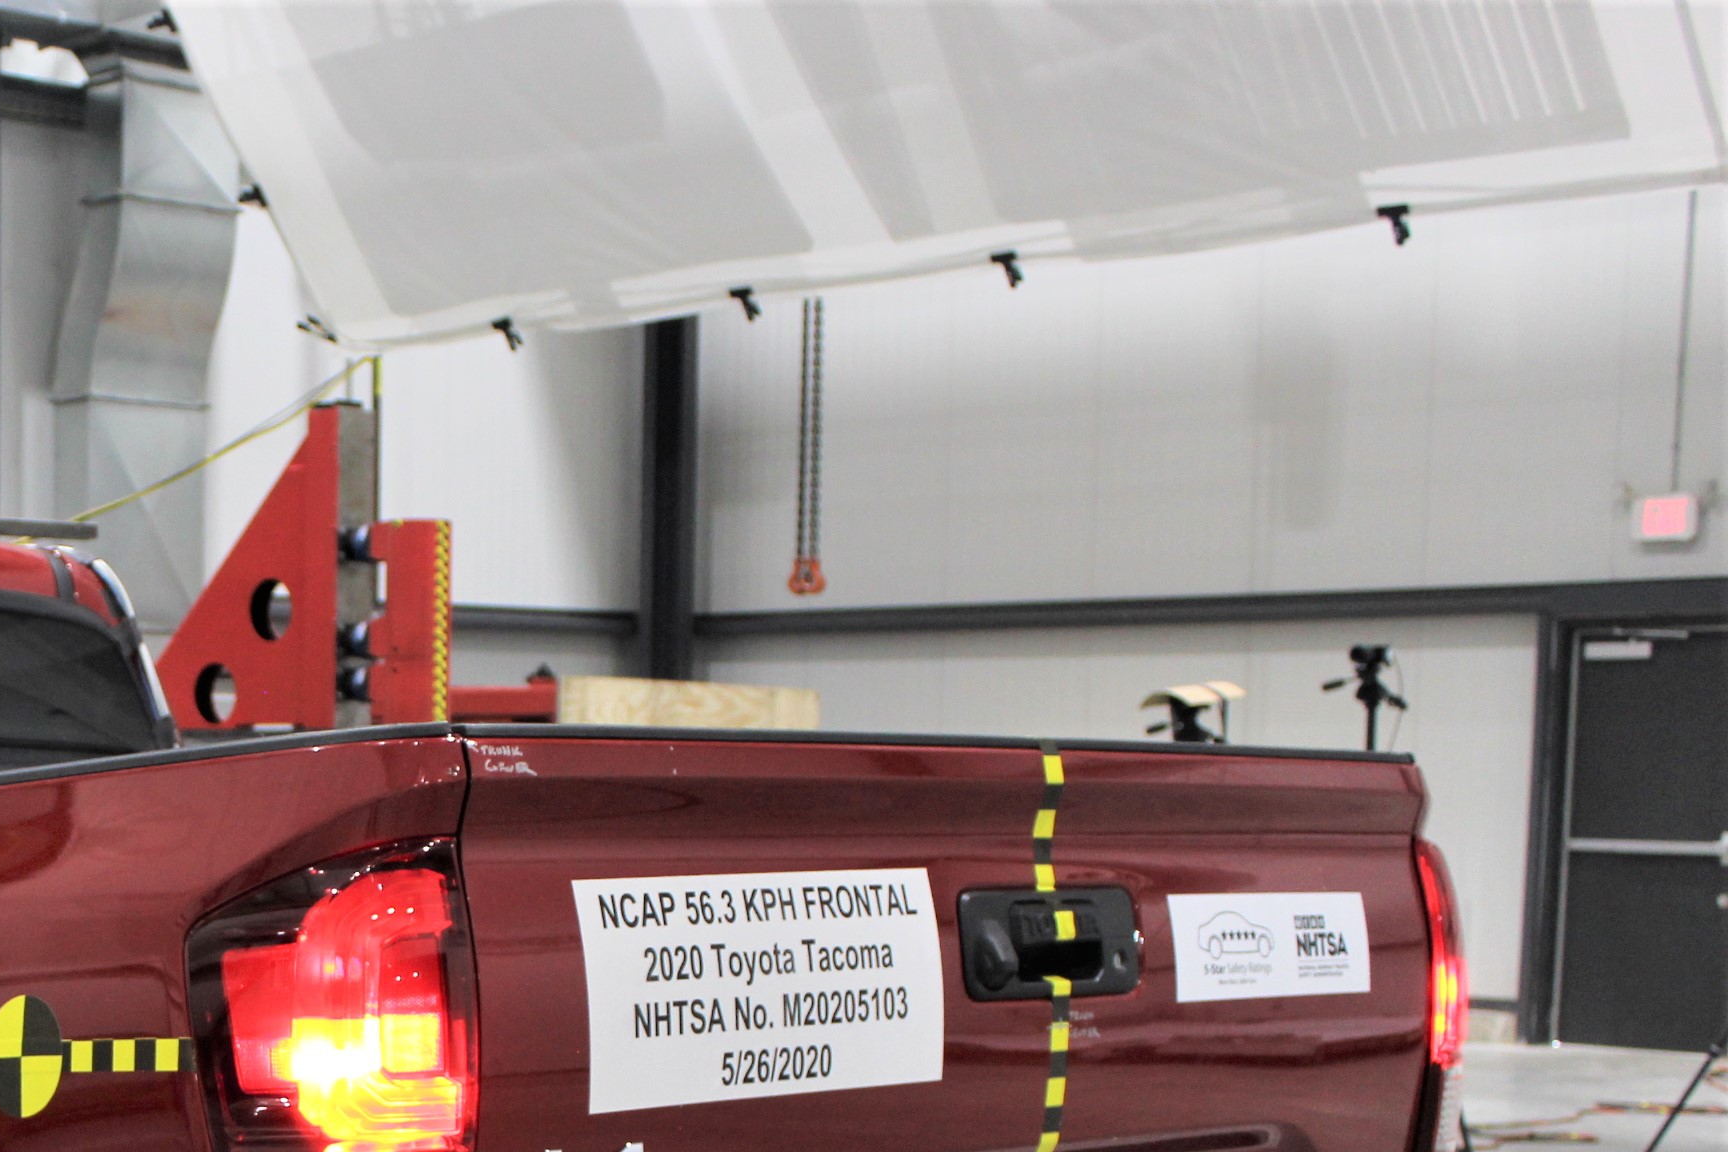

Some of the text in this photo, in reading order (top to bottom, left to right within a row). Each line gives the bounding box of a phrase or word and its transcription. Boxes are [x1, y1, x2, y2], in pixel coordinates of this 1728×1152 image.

[598, 884, 919, 929] NCAP 56.3 KPH FRONTAL
[644, 939, 894, 986] 2020 Toyota Tacoma
[1295, 932, 1349, 957] NHTSA
[634, 986, 909, 1039] NHTSA No. M20205103
[721, 1044, 833, 1087] 5/26/2020
